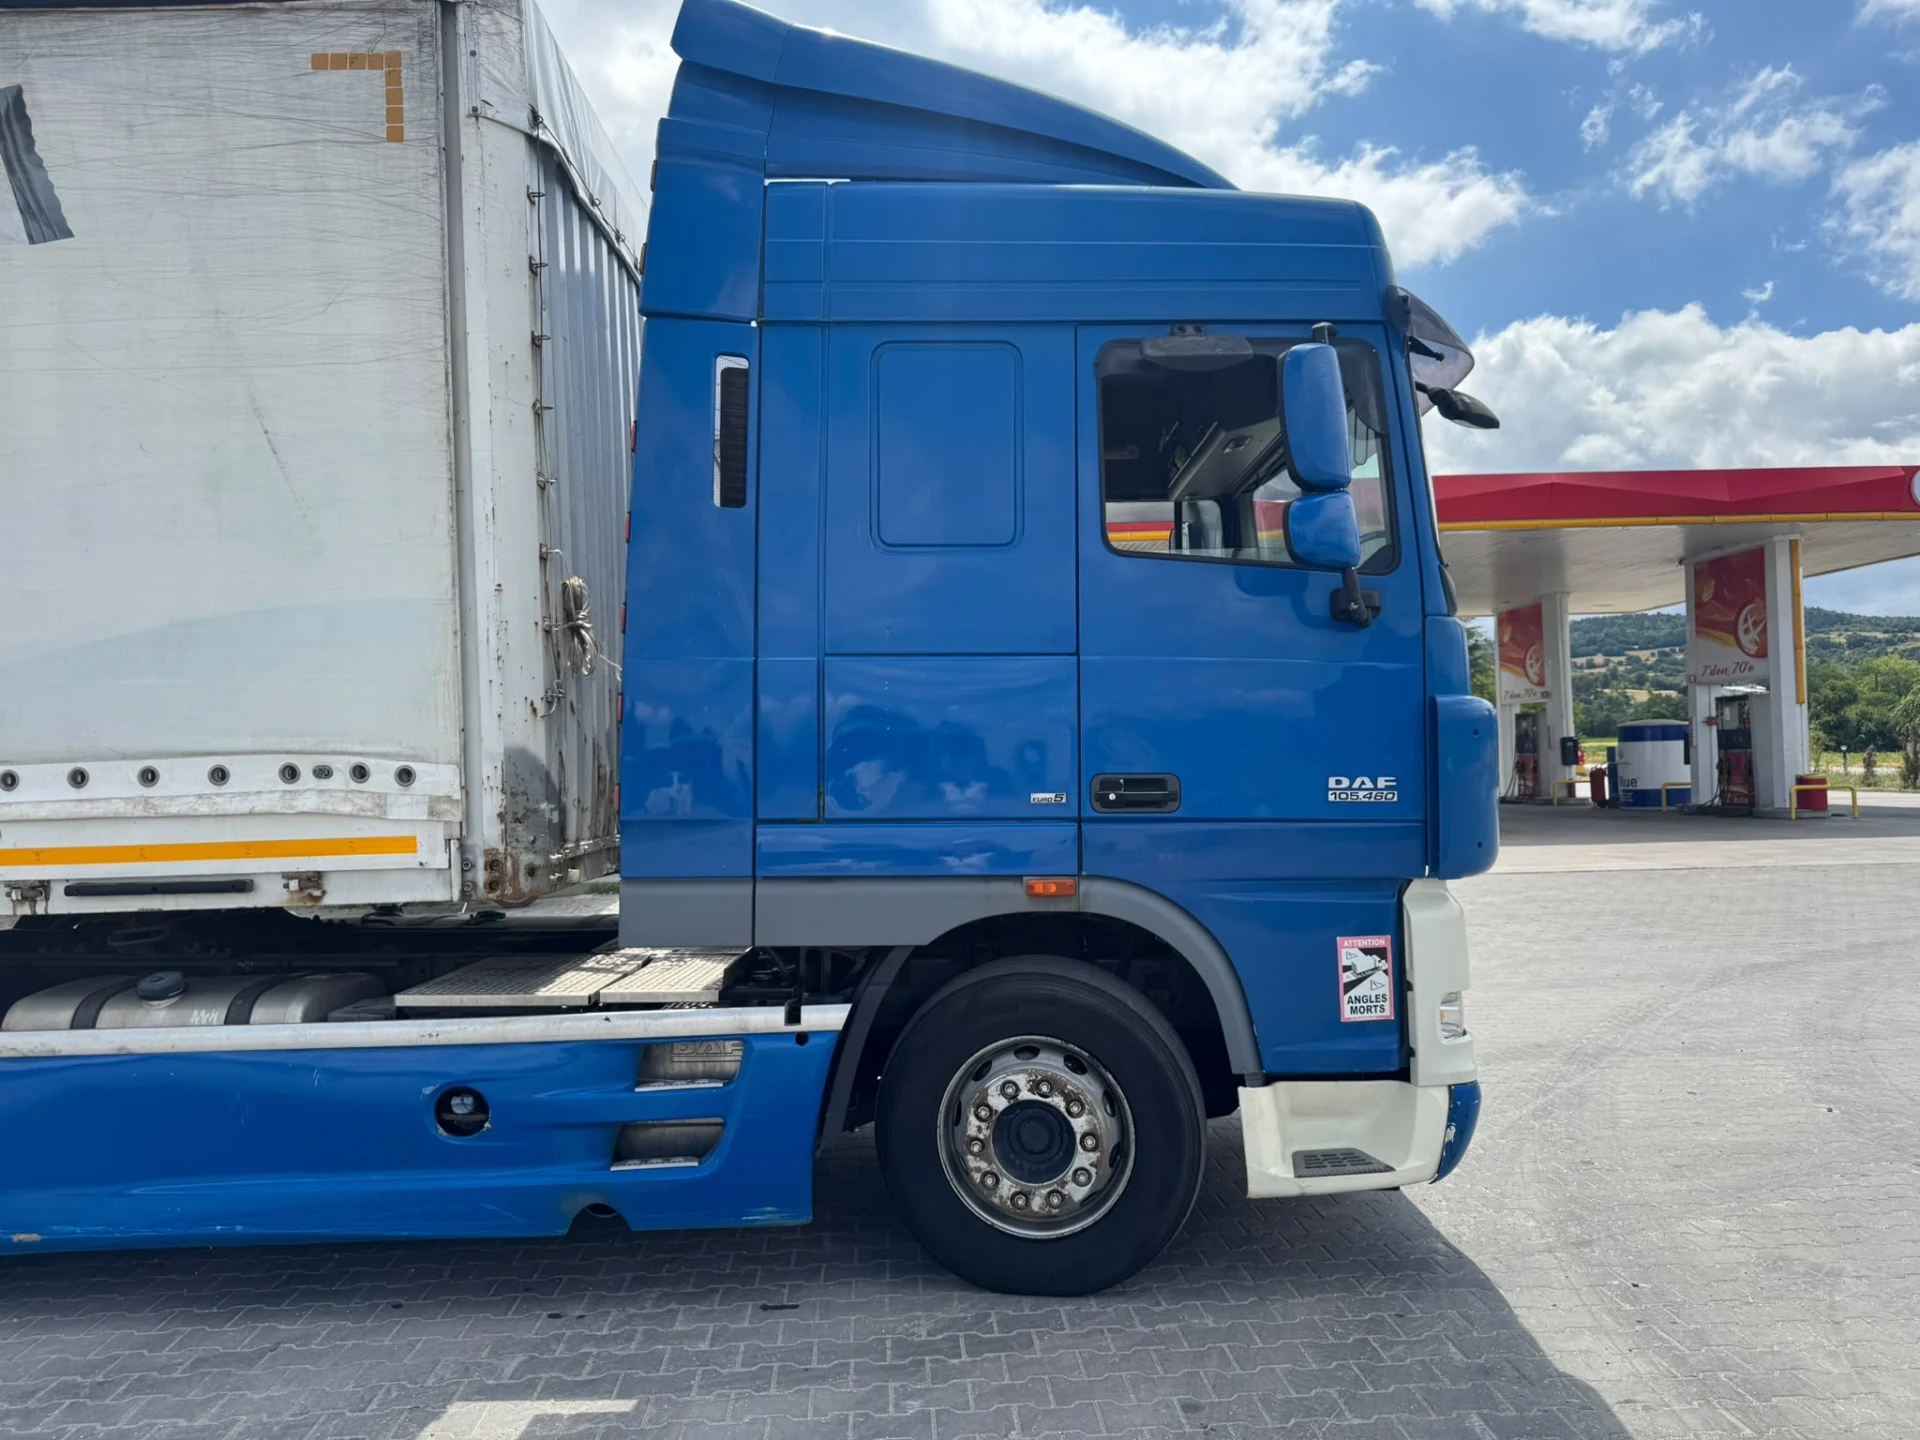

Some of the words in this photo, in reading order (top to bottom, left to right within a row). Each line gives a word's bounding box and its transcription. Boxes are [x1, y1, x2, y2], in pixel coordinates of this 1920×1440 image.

[1328, 776, 1397, 789] DAF
[1329, 791, 1396, 801] 105.460
[1343, 938, 1385, 947] ATTENTION
[1347, 994, 1388, 1005] ANGLES
[1350, 1004, 1385, 1015] MORTS
